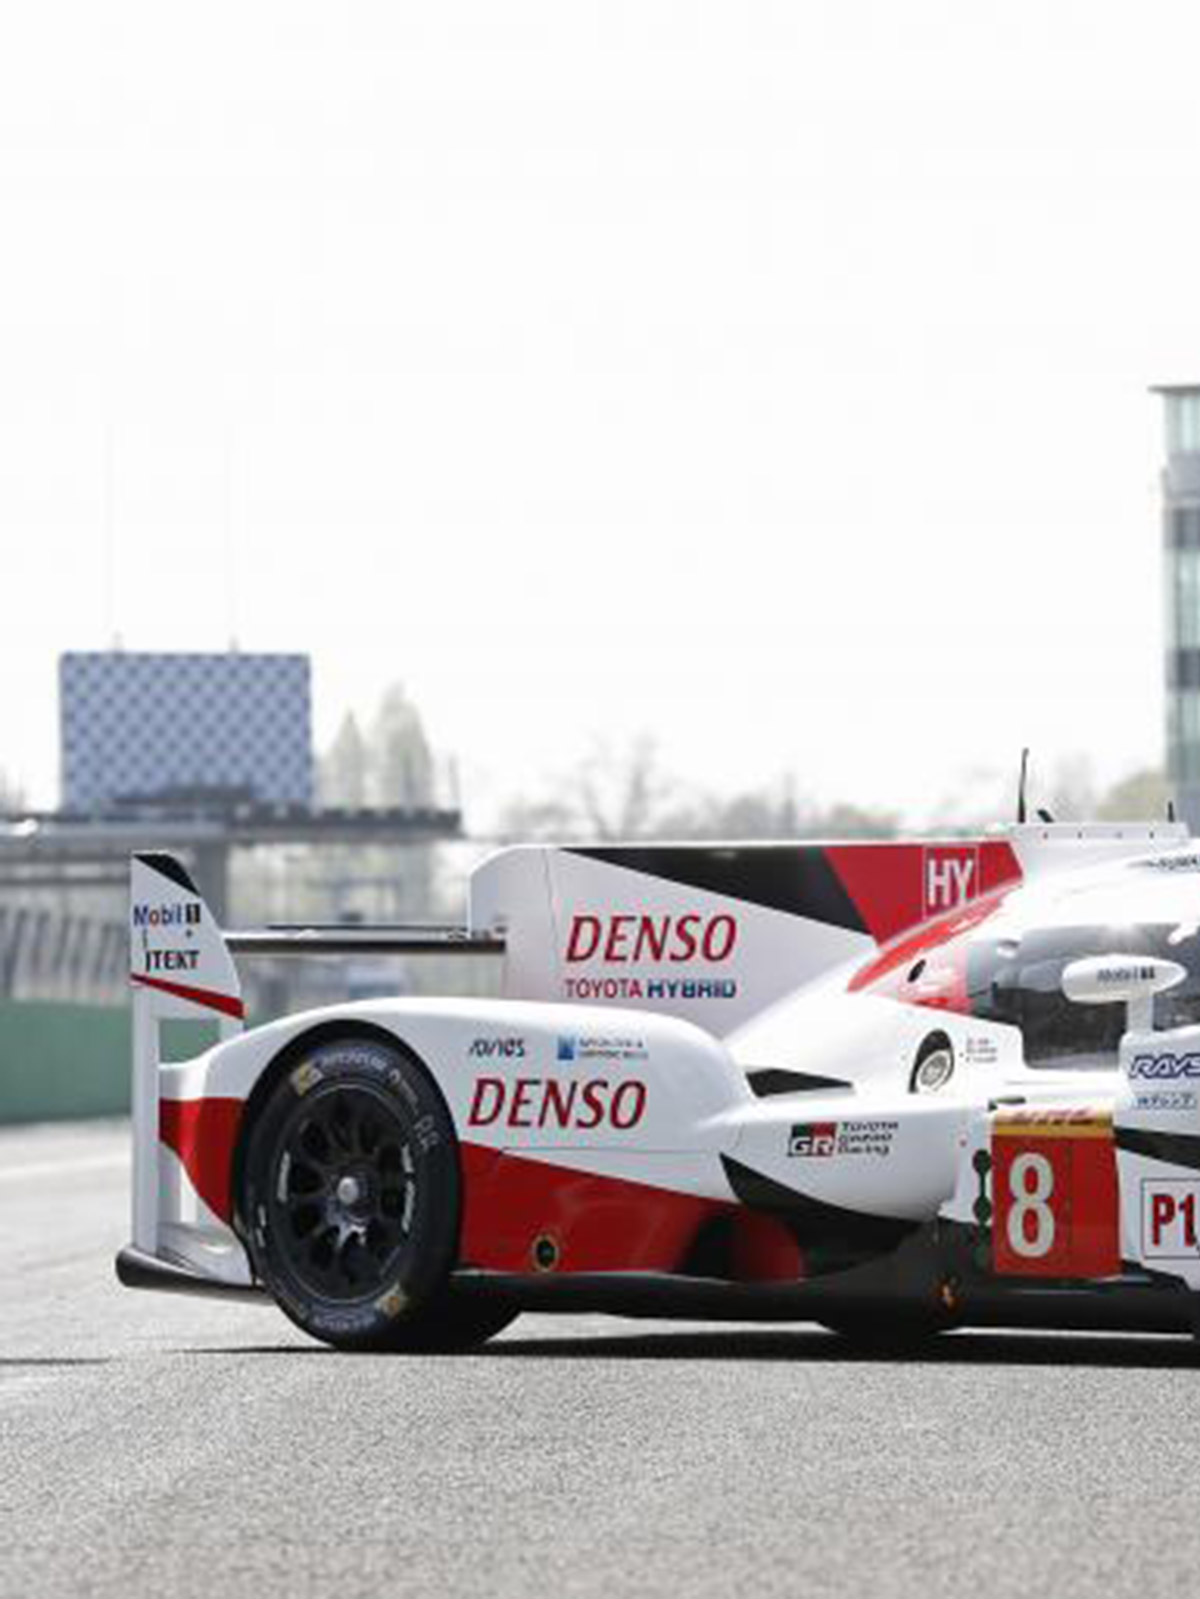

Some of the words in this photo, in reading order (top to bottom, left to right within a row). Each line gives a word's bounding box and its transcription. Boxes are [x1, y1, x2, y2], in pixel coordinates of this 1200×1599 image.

[928, 859, 974, 906] HY
[134, 904, 182, 927] Mobil
[566, 915, 737, 962] DENSO
[145, 950, 199, 972] JTEKT
[566, 978, 642, 998] TOYOTA
[648, 978, 737, 998] HYBRID
[468, 1078, 647, 1129] DENSO
[841, 1122, 899, 1132] TOYOTA
[790, 1137, 835, 1157] GR
[1007, 1152, 1055, 1258] 8
[1152, 1193, 1197, 1246] P1
